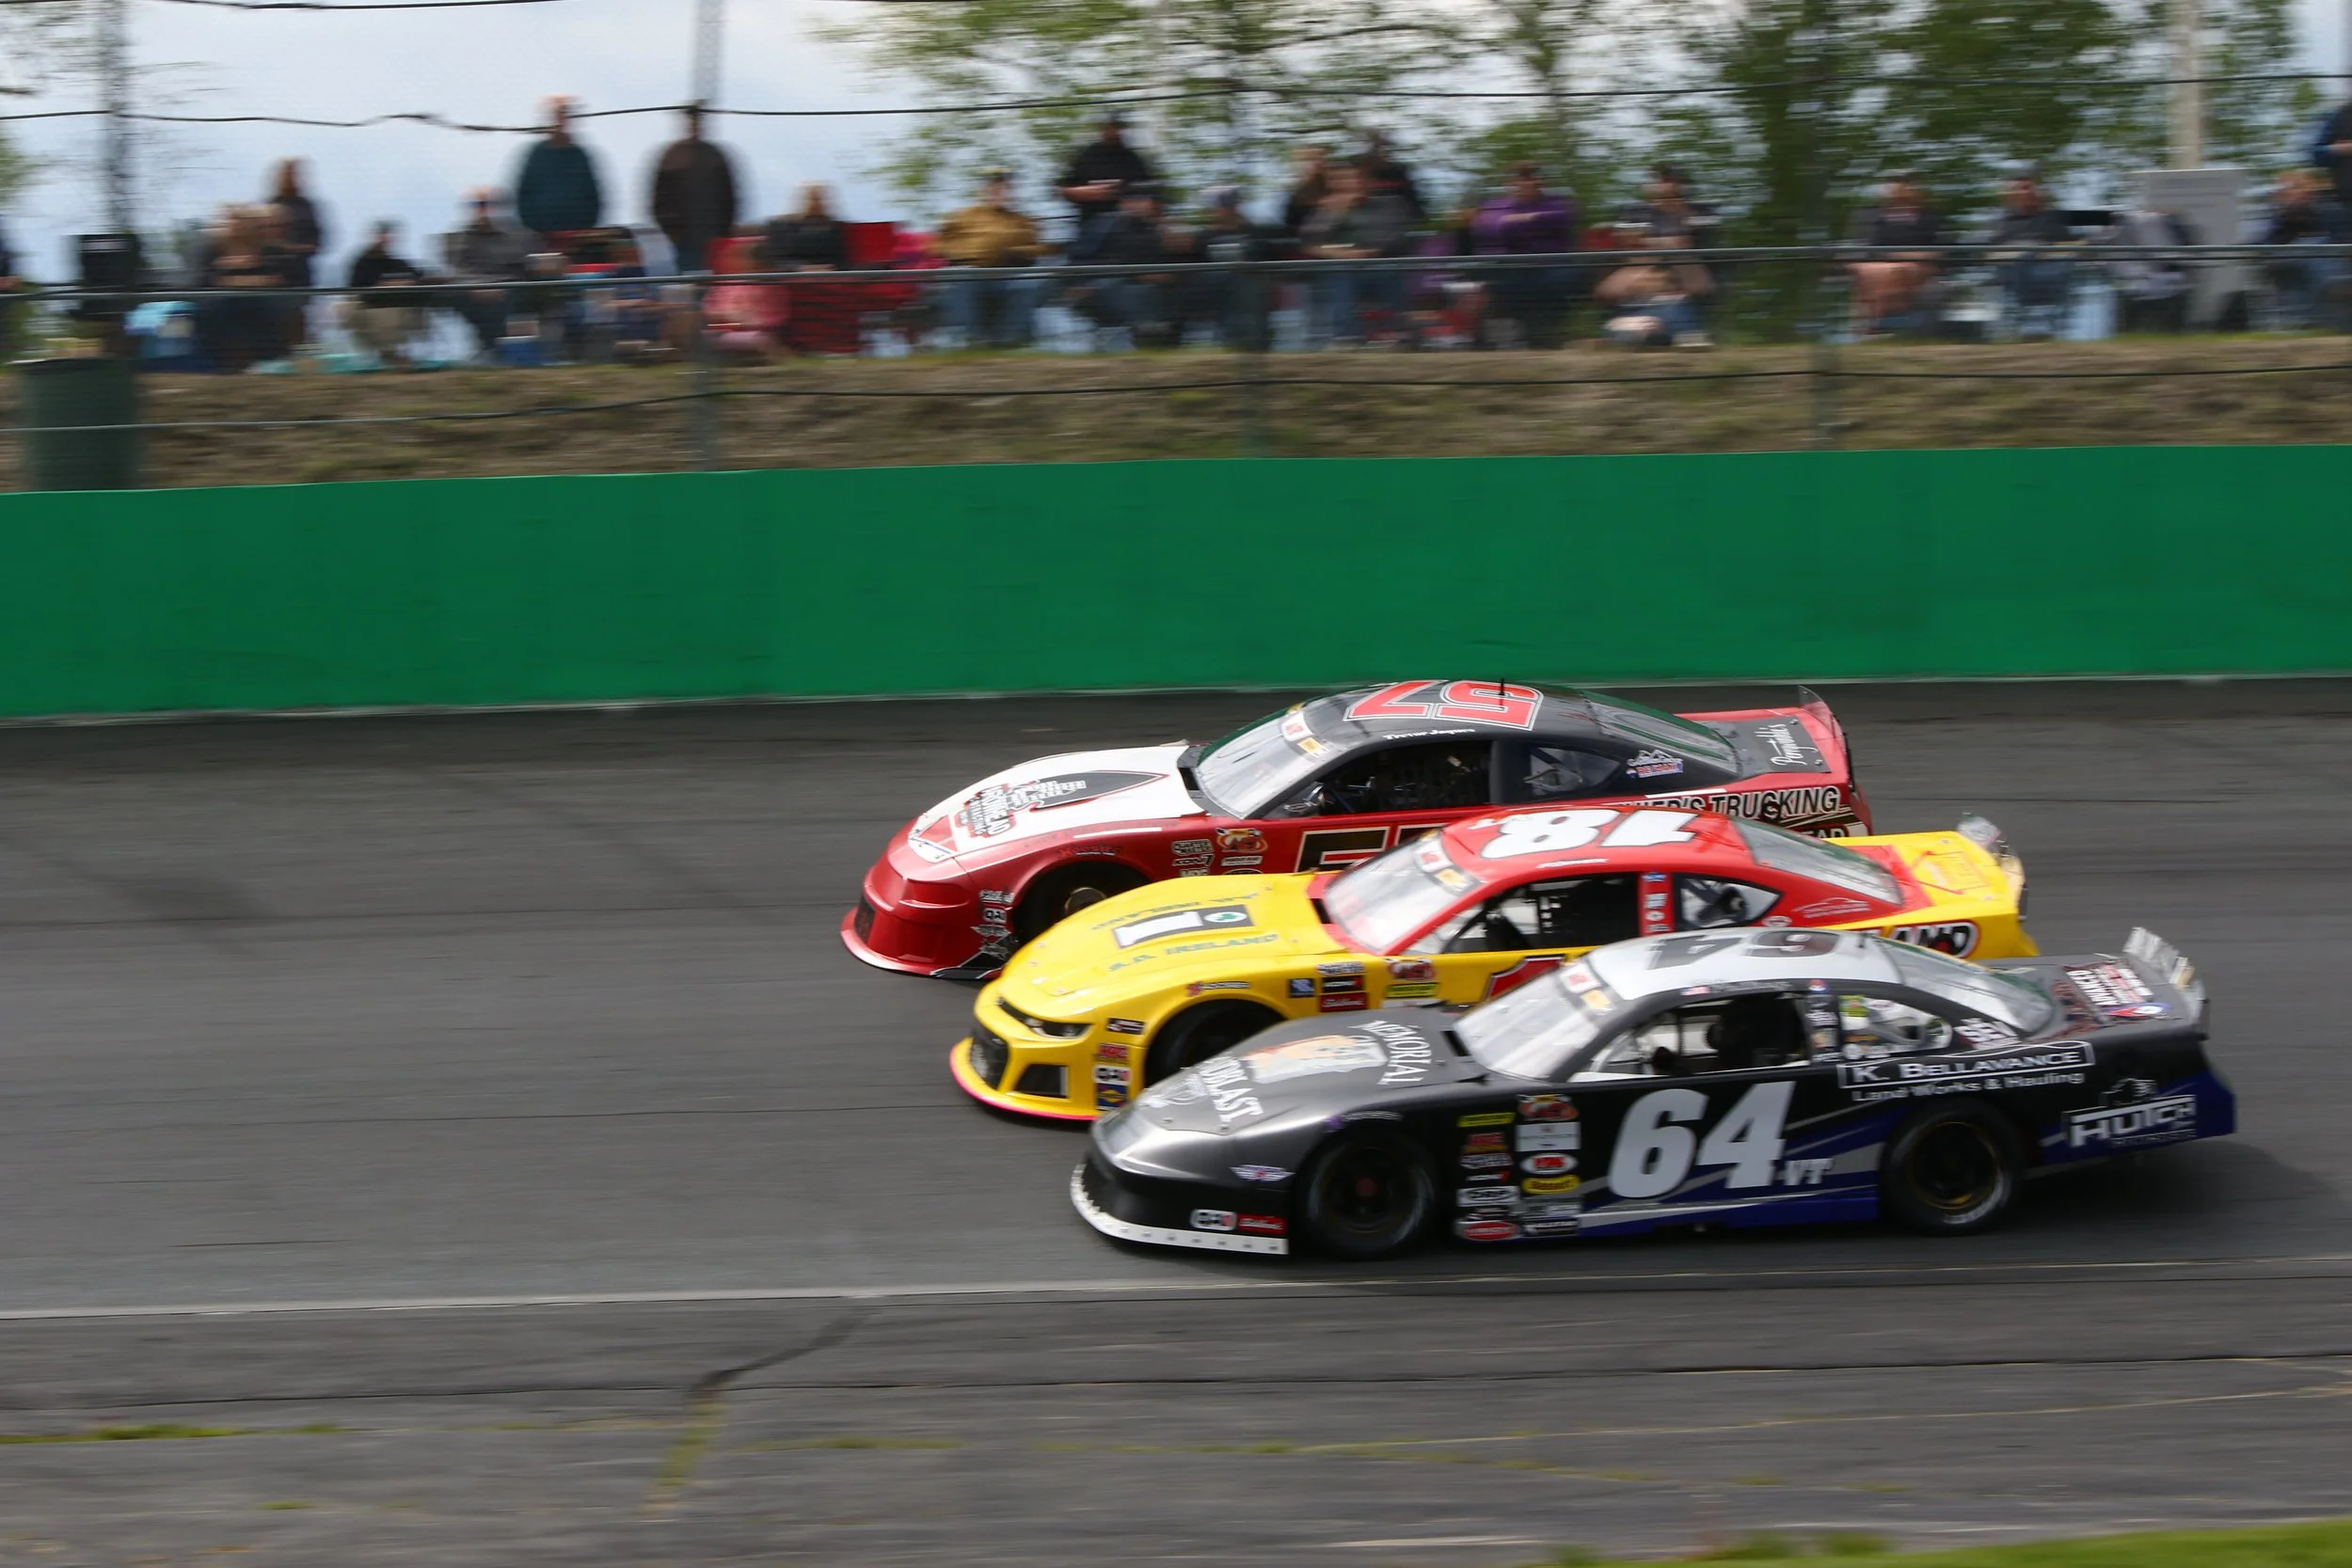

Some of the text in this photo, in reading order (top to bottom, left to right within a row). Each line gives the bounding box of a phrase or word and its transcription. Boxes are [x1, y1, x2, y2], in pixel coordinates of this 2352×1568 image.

[1343, 679, 1544, 731] 57
[1709, 785, 1841, 818] TRUCKING
[1480, 809, 1698, 859] 18
[1165, 934, 1279, 955] IRELAND
[1347, 1020, 1432, 1085] MEMORIAL
[1851, 1086, 1908, 1101] Land
[2003, 1072, 2085, 1088] Hauling
[1607, 1081, 1796, 1198] 64
[1784, 1158, 1833, 1186] VT
